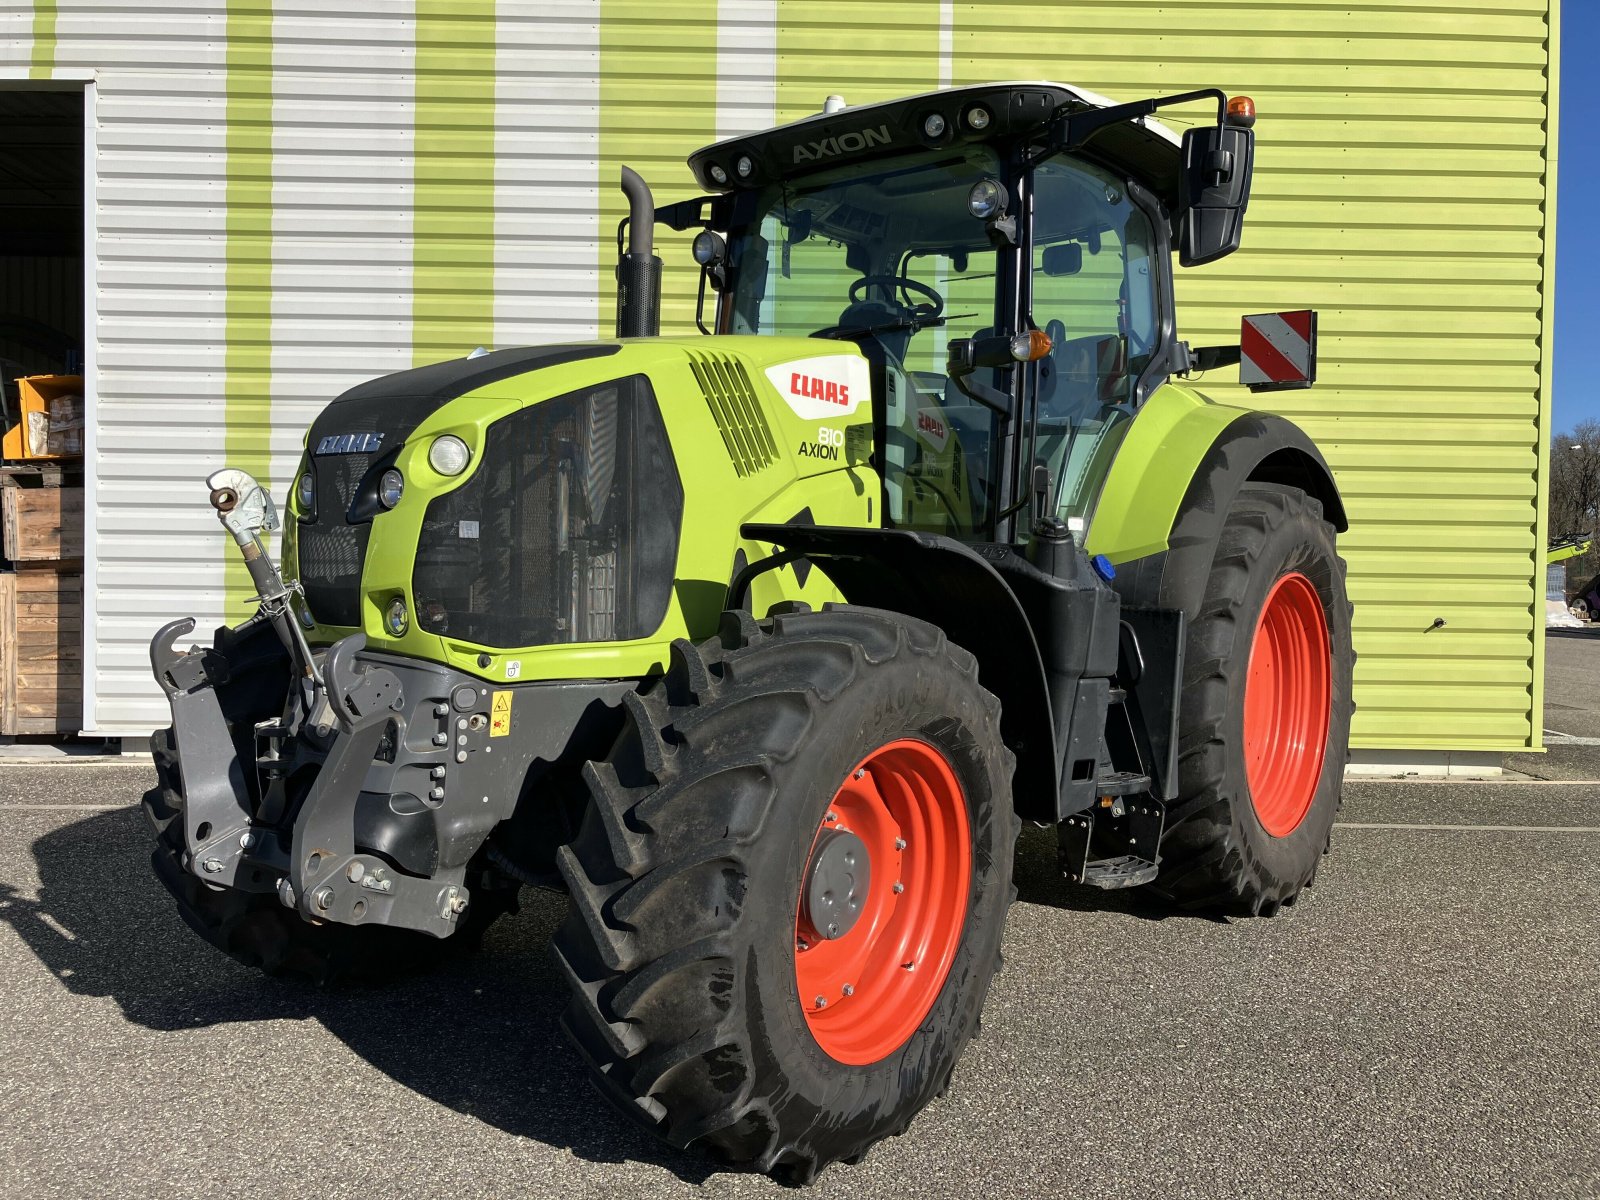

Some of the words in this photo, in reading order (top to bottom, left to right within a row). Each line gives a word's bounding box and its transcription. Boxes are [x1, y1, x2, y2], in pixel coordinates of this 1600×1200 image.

[793, 125, 892, 164] AXION
[790, 372, 849, 406] CLAAS
[316, 432, 386, 455] CLAAS
[818, 427, 844, 446] 810
[798, 441, 838, 461] AXION
